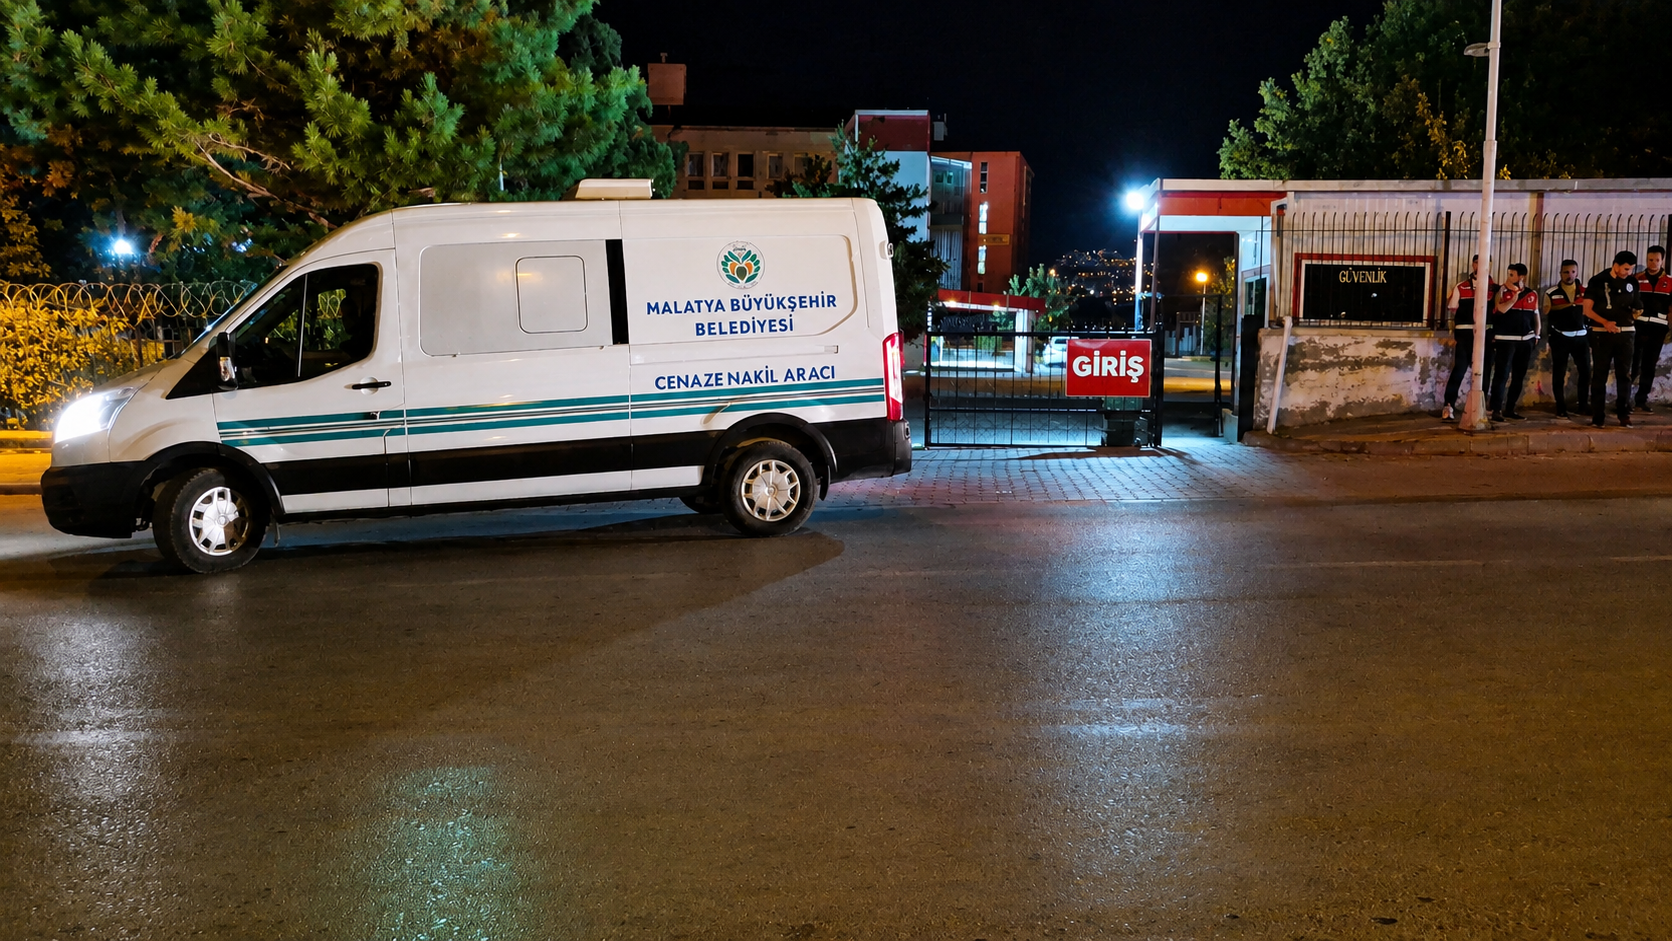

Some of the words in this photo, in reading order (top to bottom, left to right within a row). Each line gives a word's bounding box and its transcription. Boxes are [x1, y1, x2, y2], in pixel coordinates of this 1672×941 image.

[1339, 267, 1387, 283] GÜVENLİK
[646, 299, 726, 315] MALATYA
[730, 291, 837, 313] BÜYÜKŞEHİR
[695, 314, 794, 336] BELEDİYESİ
[655, 372, 723, 390] CENAZE
[727, 365, 778, 386] NAKİL
[783, 365, 835, 382] ARACI
[1072, 350, 1144, 383] GİRİŞ
